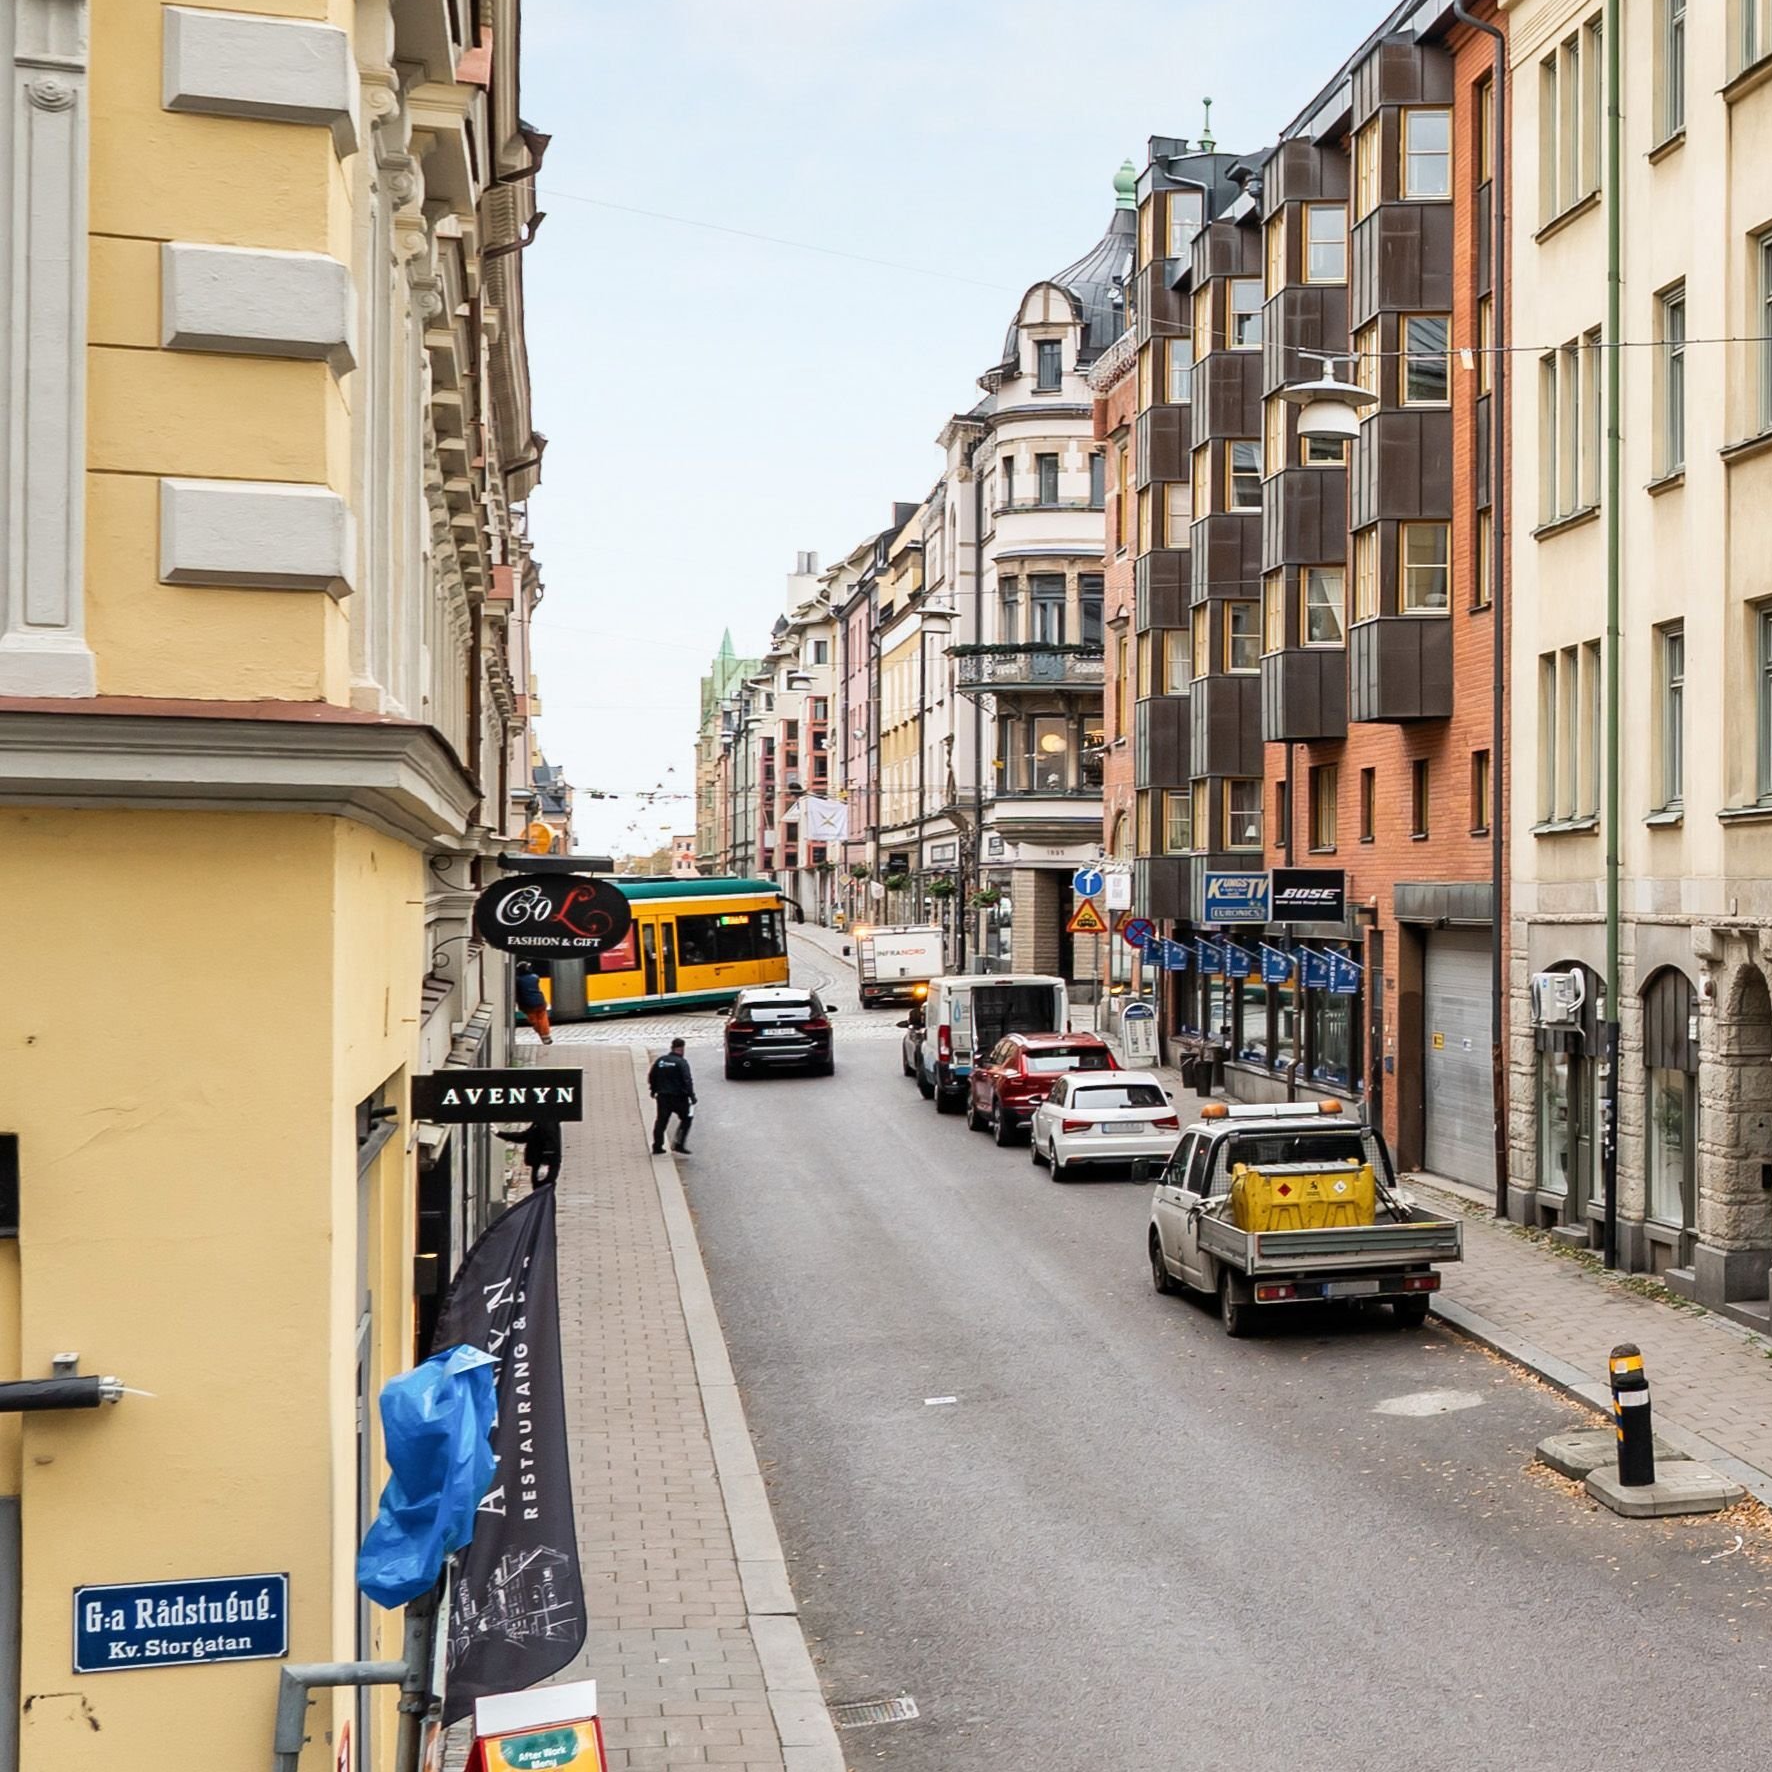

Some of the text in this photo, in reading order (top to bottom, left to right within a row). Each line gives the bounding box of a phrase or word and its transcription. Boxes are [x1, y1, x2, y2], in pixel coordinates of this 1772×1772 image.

[1274, 888, 1341, 899] BOSE
[1214, 908, 1262, 917] EURONICS
[507, 936, 601, 947] FASHION & GIFT
[441, 1087, 575, 1106] AVENYN
[513, 1315, 527, 1330] &
[514, 1342, 539, 1520] RESTAURANG
[86, 1601, 126, 1633] G:a
[108, 1635, 252, 1660] Kv. Storgatan
[519, 1745, 567, 1763] After Work
